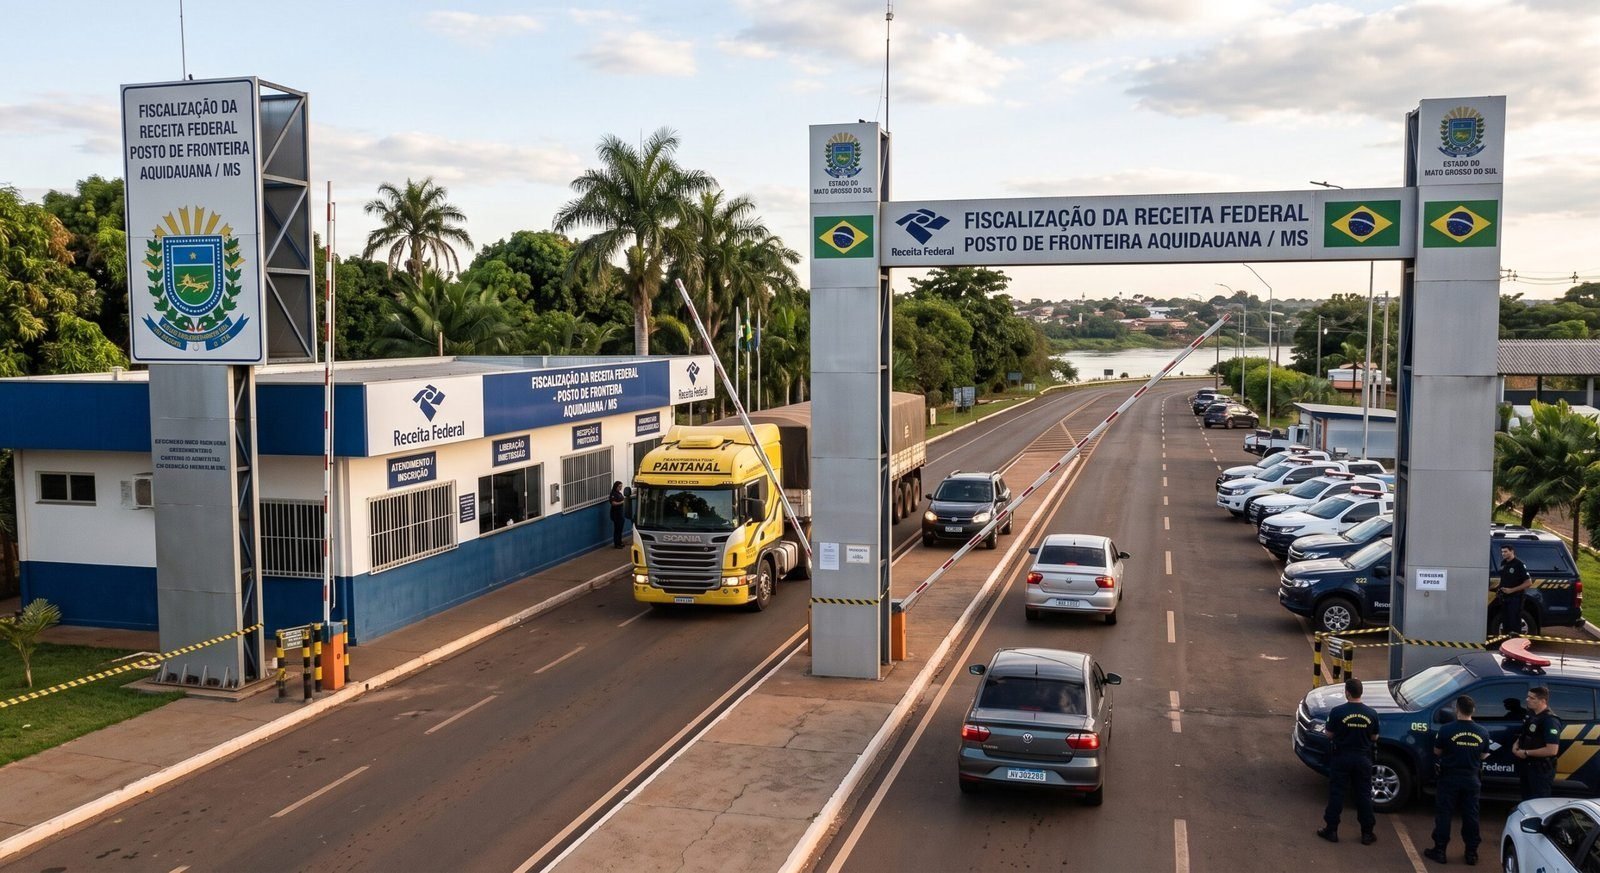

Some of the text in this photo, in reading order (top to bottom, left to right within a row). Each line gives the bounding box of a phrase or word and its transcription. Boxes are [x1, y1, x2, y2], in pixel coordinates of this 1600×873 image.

[139, 98, 238, 118] FISCALIZAÇÃO DA
[140, 119, 238, 139] RECEITA FEDERAL
[130, 140, 250, 160] POSTO DE FRONTEIRA
[140, 162, 241, 180] AQUIDAUANA / MS
[1443, 160, 1469, 168] ESTADO
[1445, 168, 1472, 176] GROSSO
[1485, 167, 1498, 175] SUL
[965, 203, 1310, 231] FISCALIZAÇÃO DA RECEITA FEDERAL
[965, 229, 1309, 253] POSTO DE FRONTEIRA AQUIDAUANA / MS
[891, 246, 954, 256] Receita Federal
[532, 367, 639, 389] FISCALIZAÇÃO DA RECEITA FEDERAL
[557, 390, 579, 403] POSTO
[580, 389, 590, 400] DE
[590, 383, 623, 399] FRONTEIRA
[678, 385, 708, 399] Receita Federal
[563, 403, 604, 418] AQUIDAUANA
[608, 398, 618, 410] MS
[393, 420, 465, 447] Receita Federal
[499, 439, 525, 452] LIBERAÇÃO
[391, 457, 430, 473] ATENDIMENTO
[652, 462, 721, 472] PANTANAL
[397, 468, 429, 483] INSCRIÇÃO
[663, 535, 702, 543] SCANIA
[1482, 761, 1515, 773] Federal
